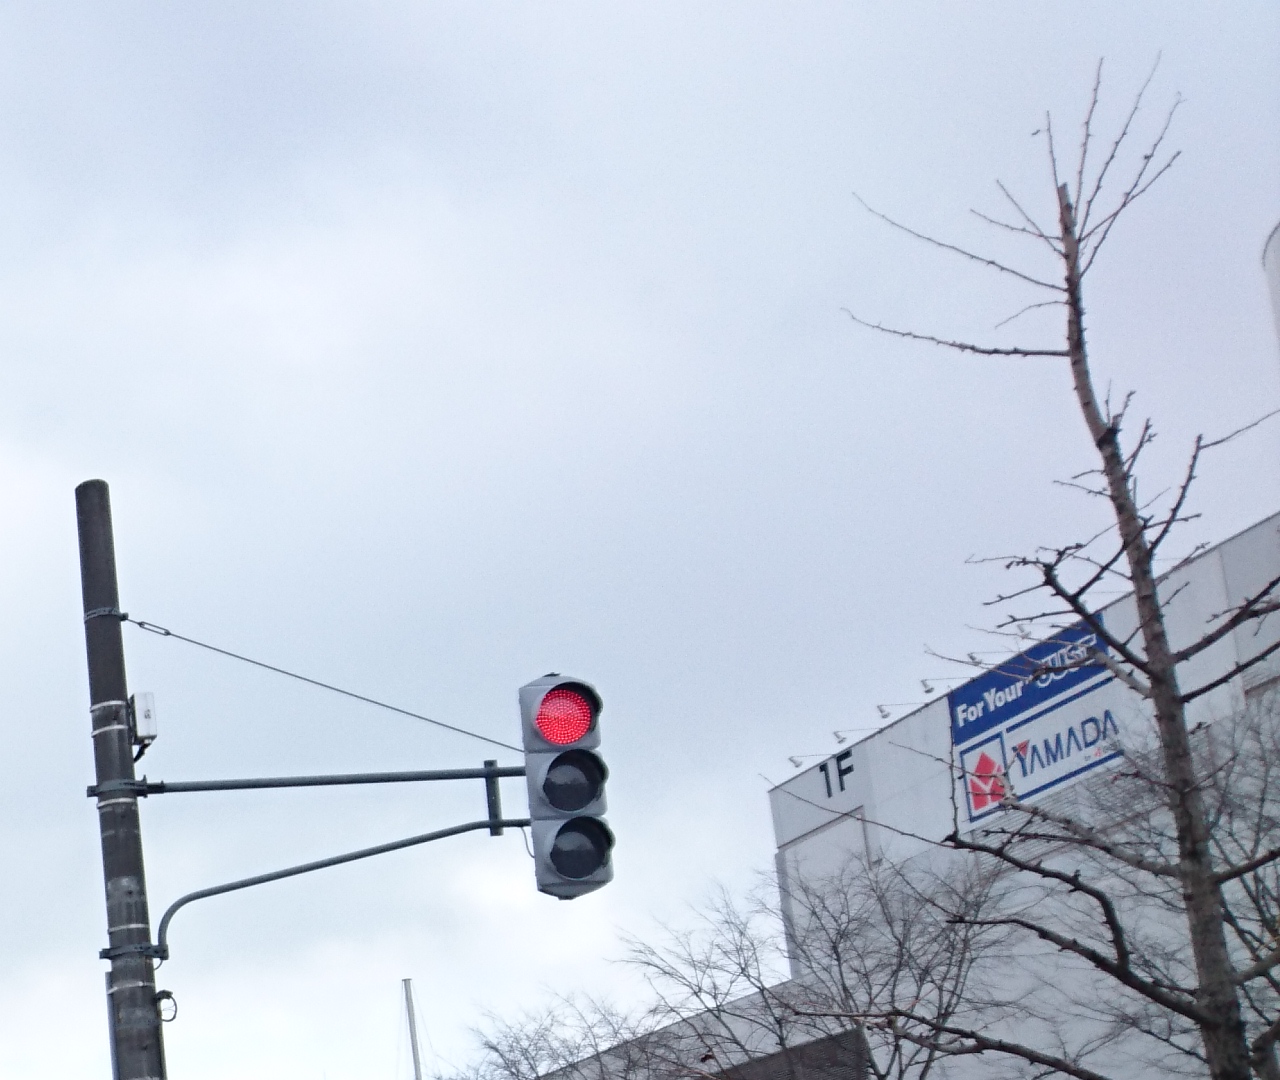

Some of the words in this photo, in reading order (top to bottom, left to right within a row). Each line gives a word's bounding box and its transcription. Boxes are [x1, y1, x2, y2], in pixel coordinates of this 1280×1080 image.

[956, 703, 985, 728] For
[983, 682, 1024, 712] Your
[1011, 709, 1120, 778] YAMADA
